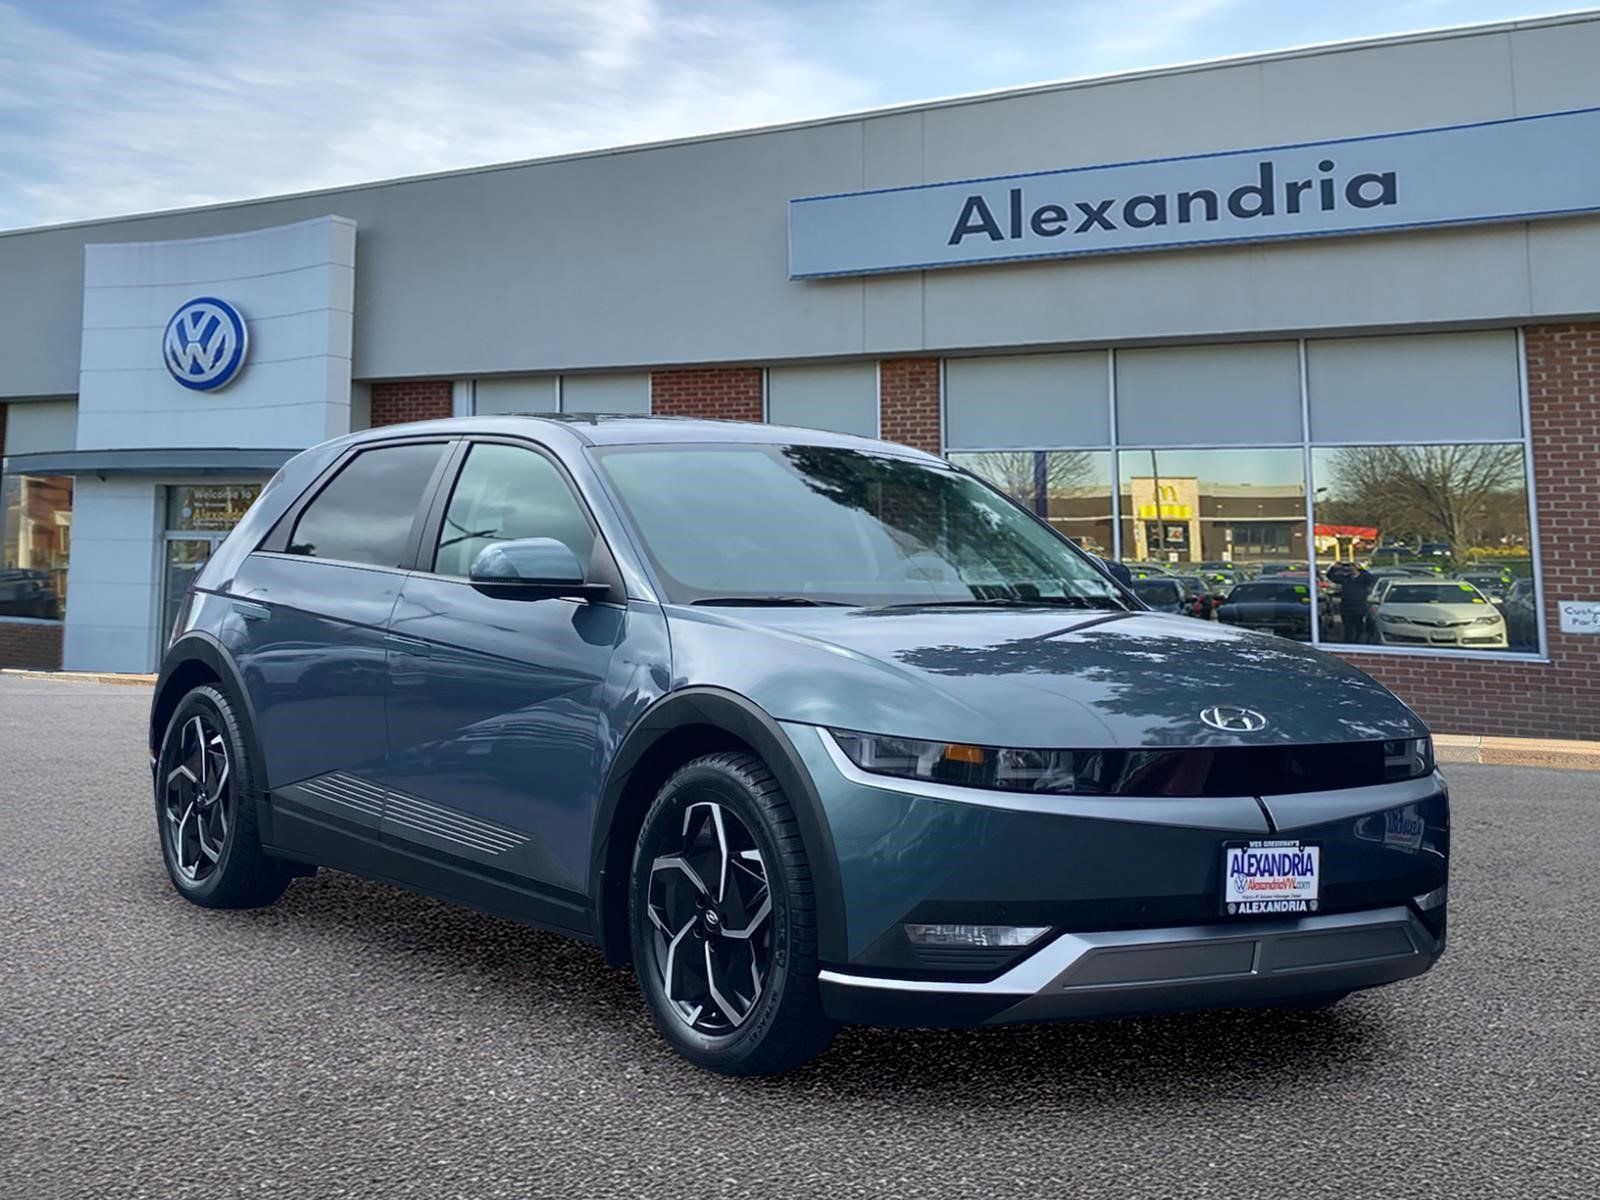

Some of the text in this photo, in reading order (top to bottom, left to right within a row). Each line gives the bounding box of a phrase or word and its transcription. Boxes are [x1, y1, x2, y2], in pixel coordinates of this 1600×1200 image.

[947, 159, 1398, 246] Alexandria
[1230, 853, 1314, 877] ALEXANDRIA
[1238, 900, 1308, 914] ALEXANDRIA
